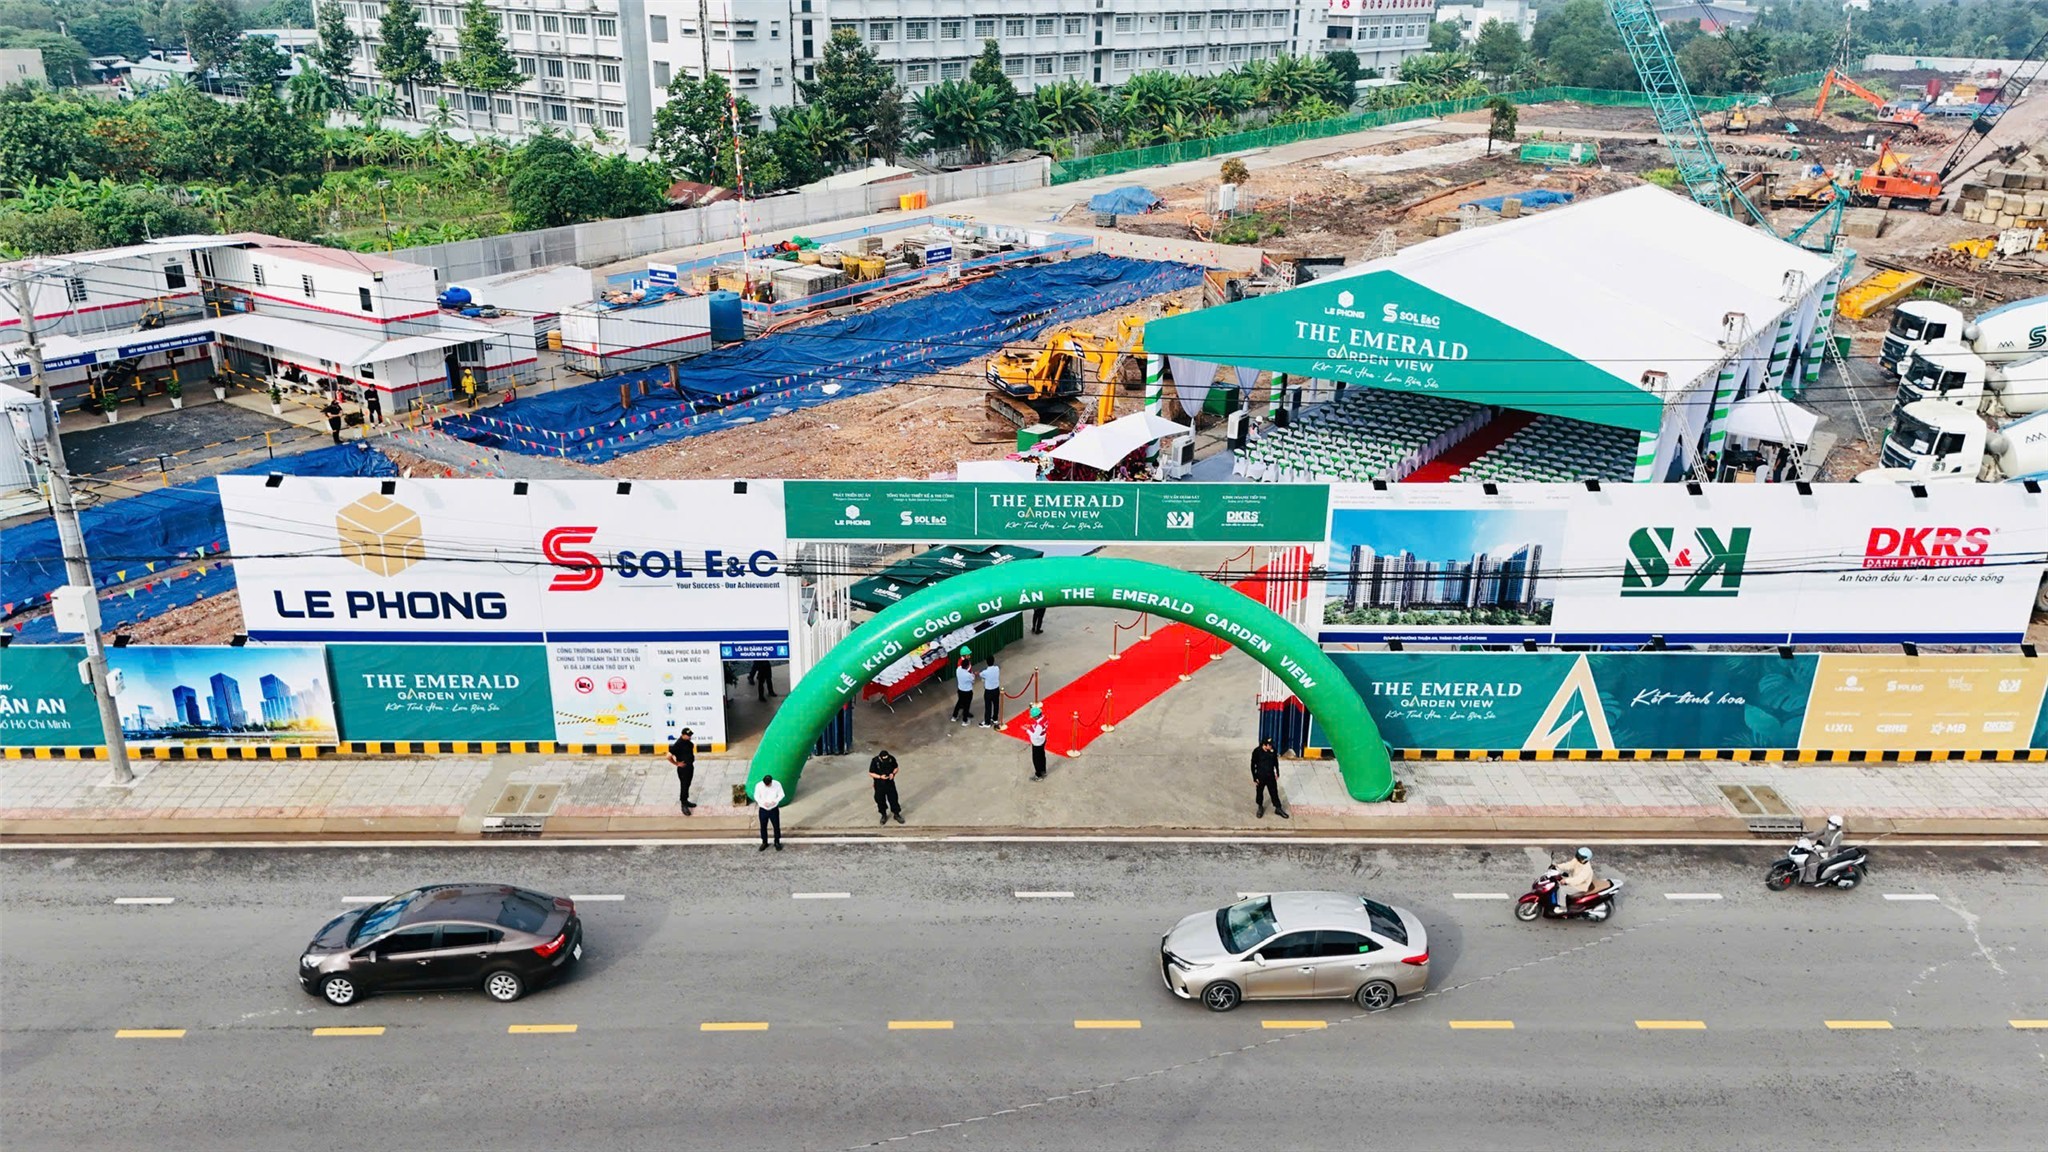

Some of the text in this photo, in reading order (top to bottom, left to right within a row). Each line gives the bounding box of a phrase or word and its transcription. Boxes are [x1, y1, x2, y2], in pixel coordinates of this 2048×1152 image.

[1324, 307, 1365, 319] LE PHONG
[1400, 312, 1440, 326] SOL E&C
[1295, 321, 1468, 360] THE EMERALD
[1327, 344, 1433, 373] GARDEN VIEW
[990, 494, 1124, 508] THE EMERALD
[1018, 507, 1066, 518] GARDEN
[1226, 511, 1258, 520] DKRS
[1865, 528, 1991, 556] DKRS
[616, 549, 779, 578] SOL E&C
[1839, 572, 2004, 584] An toàn đầu tư An cư cuộc sống
[273, 590, 507, 619] LE PHONG
[836, 588, 1316, 694] LỄ KHỞI CÔNG DỰ ÁN THE EMERALD GARDEN VIEW
[362, 674, 519, 688] THE EMERALD
[398, 688, 493, 700] GARDEN VIEW
[1372, 682, 1522, 697] THE EMERALD
[1401, 696, 1493, 708] GARDEN VIEW
[1717, 692, 1745, 705] hoa
[36, 699, 66, 714] AN
[10, 719, 26, 729] Hồ
[28, 719, 45, 729] Chí
[47, 719, 71, 729] Minh
[1825, 724, 1854, 732] LIXIL
[1946, 724, 1966, 733] MB
